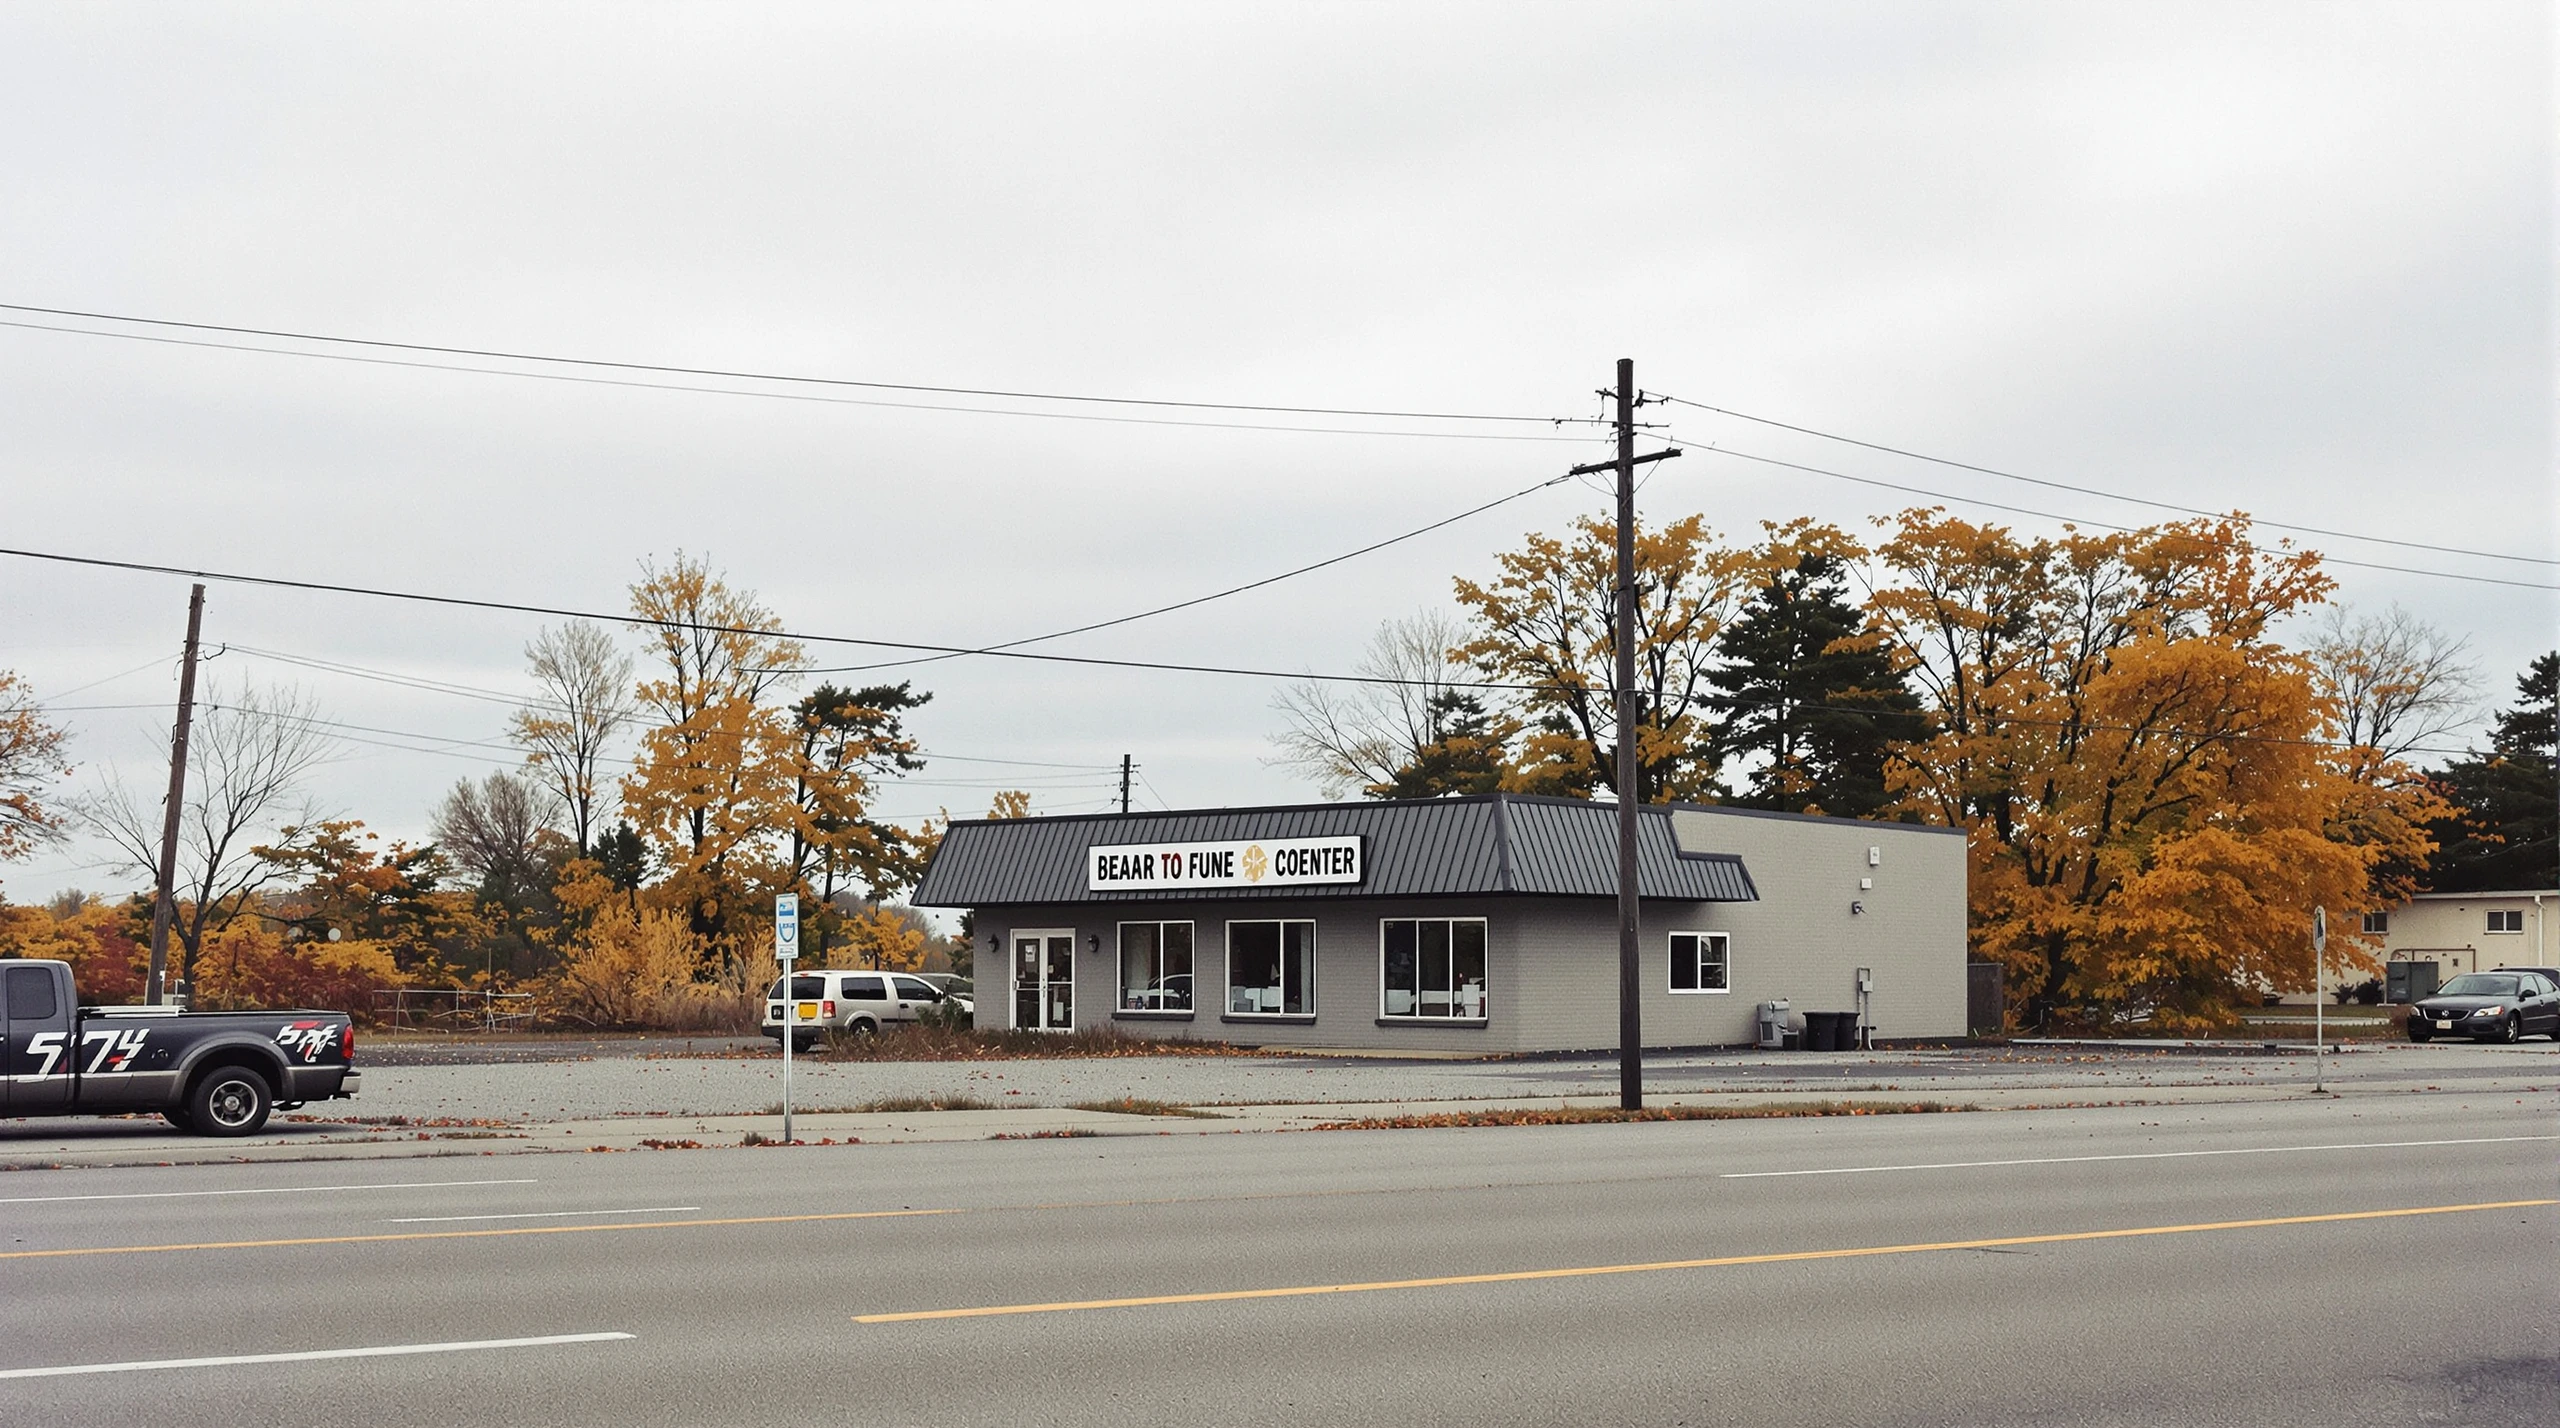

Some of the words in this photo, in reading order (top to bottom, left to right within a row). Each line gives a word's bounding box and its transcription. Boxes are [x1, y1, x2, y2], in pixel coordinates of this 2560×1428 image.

[1097, 854, 1155, 881] BEAAR
[1161, 852, 1182, 880] TO
[1188, 850, 1235, 878] FUNE
[1274, 846, 1356, 877] COENTER
